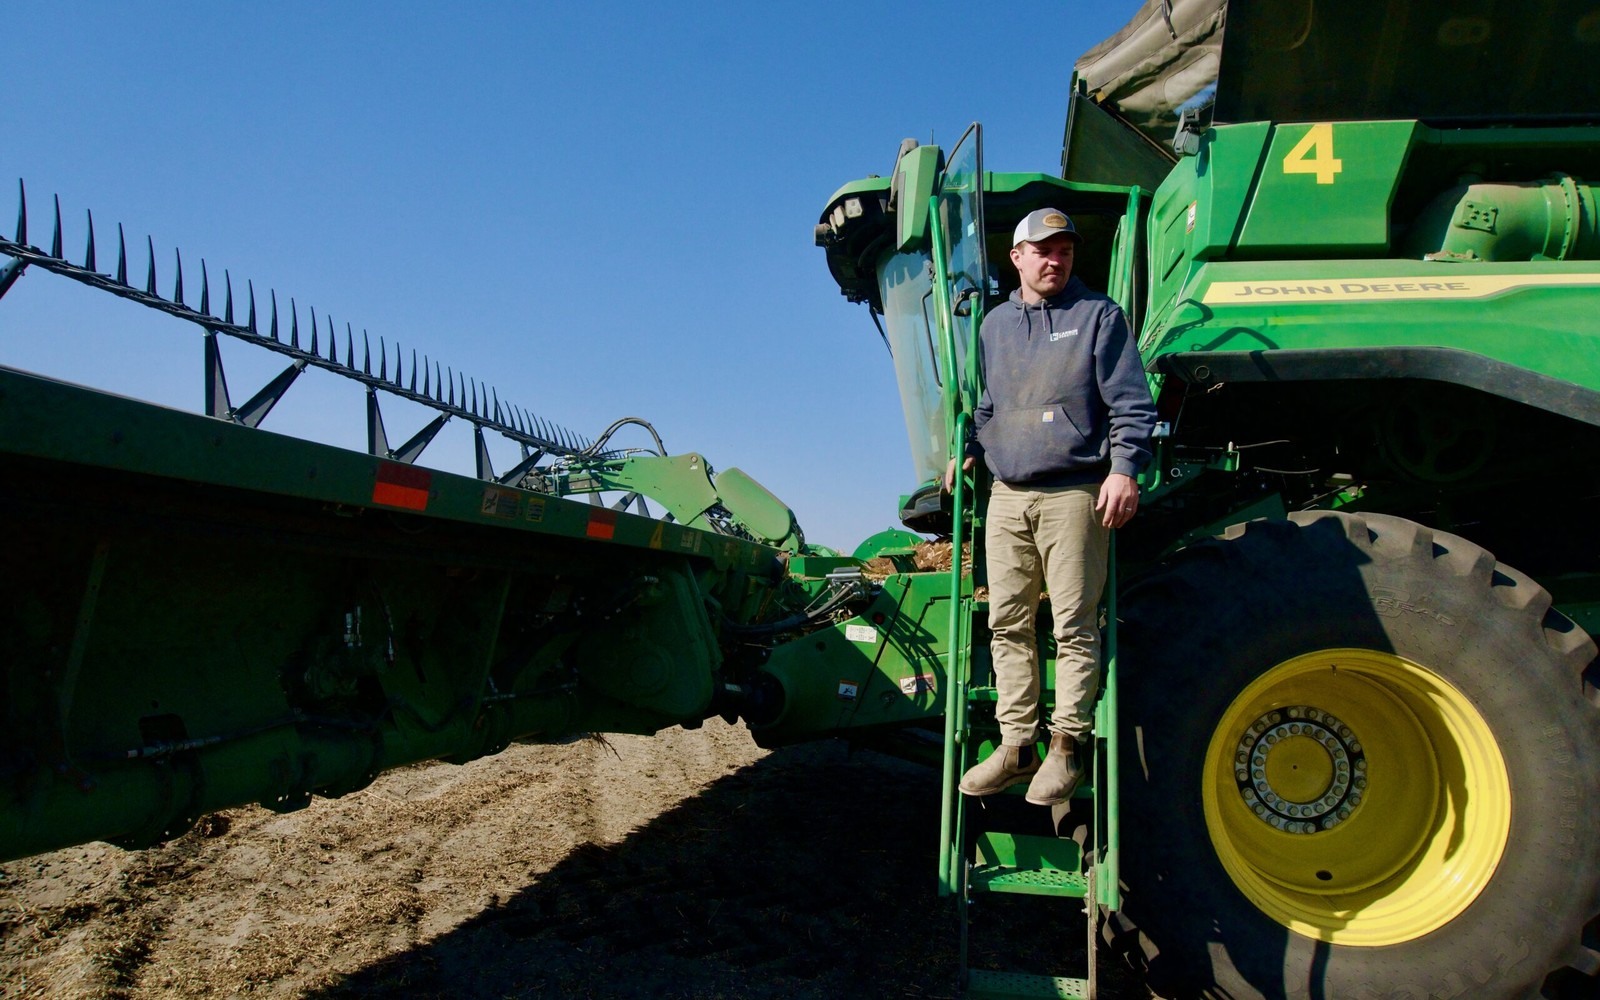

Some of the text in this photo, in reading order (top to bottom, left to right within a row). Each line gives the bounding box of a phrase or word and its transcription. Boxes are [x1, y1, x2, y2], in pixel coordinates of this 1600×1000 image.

[1283, 122, 1342, 184] 4
[1234, 282, 1471, 297] JOHN DEERE
